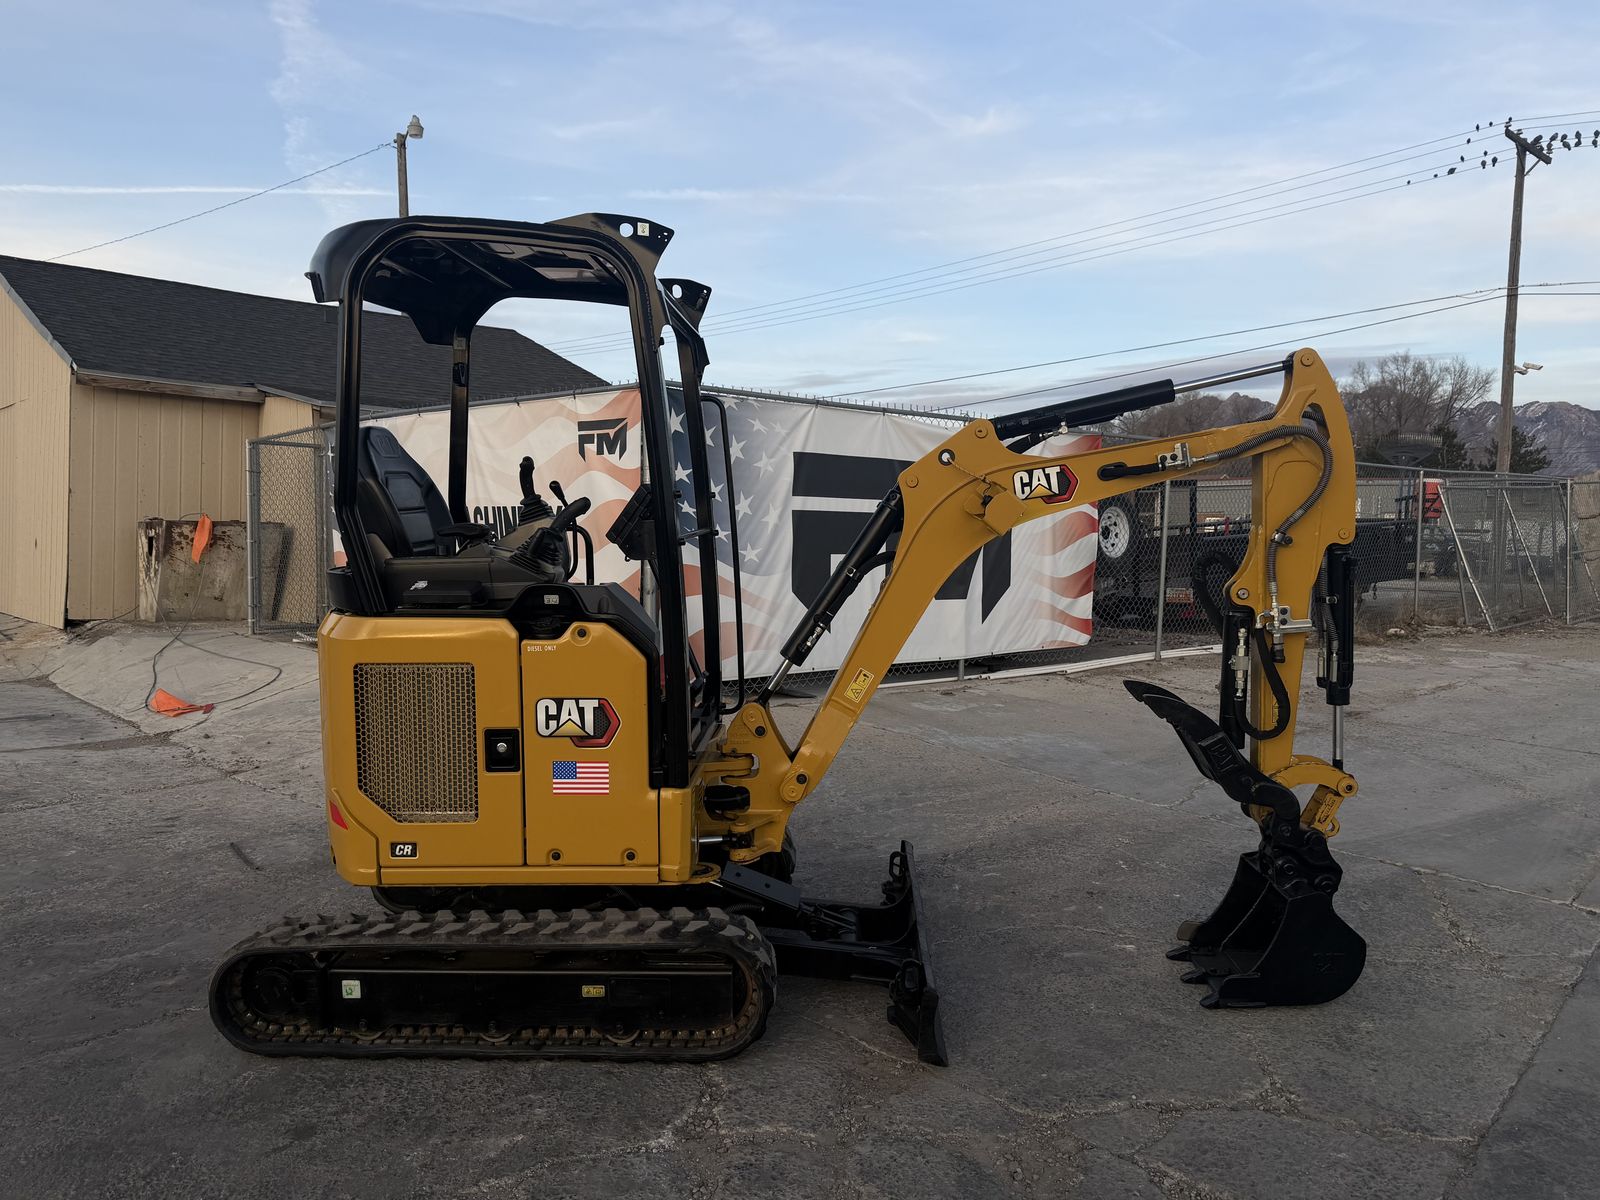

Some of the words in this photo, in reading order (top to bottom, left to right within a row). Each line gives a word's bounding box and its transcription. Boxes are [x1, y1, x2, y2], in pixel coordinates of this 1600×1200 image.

[577, 417, 628, 463] FM
[1013, 466, 1061, 500] CAT
[536, 699, 599, 736] CAT
[395, 844, 412, 856] CR
